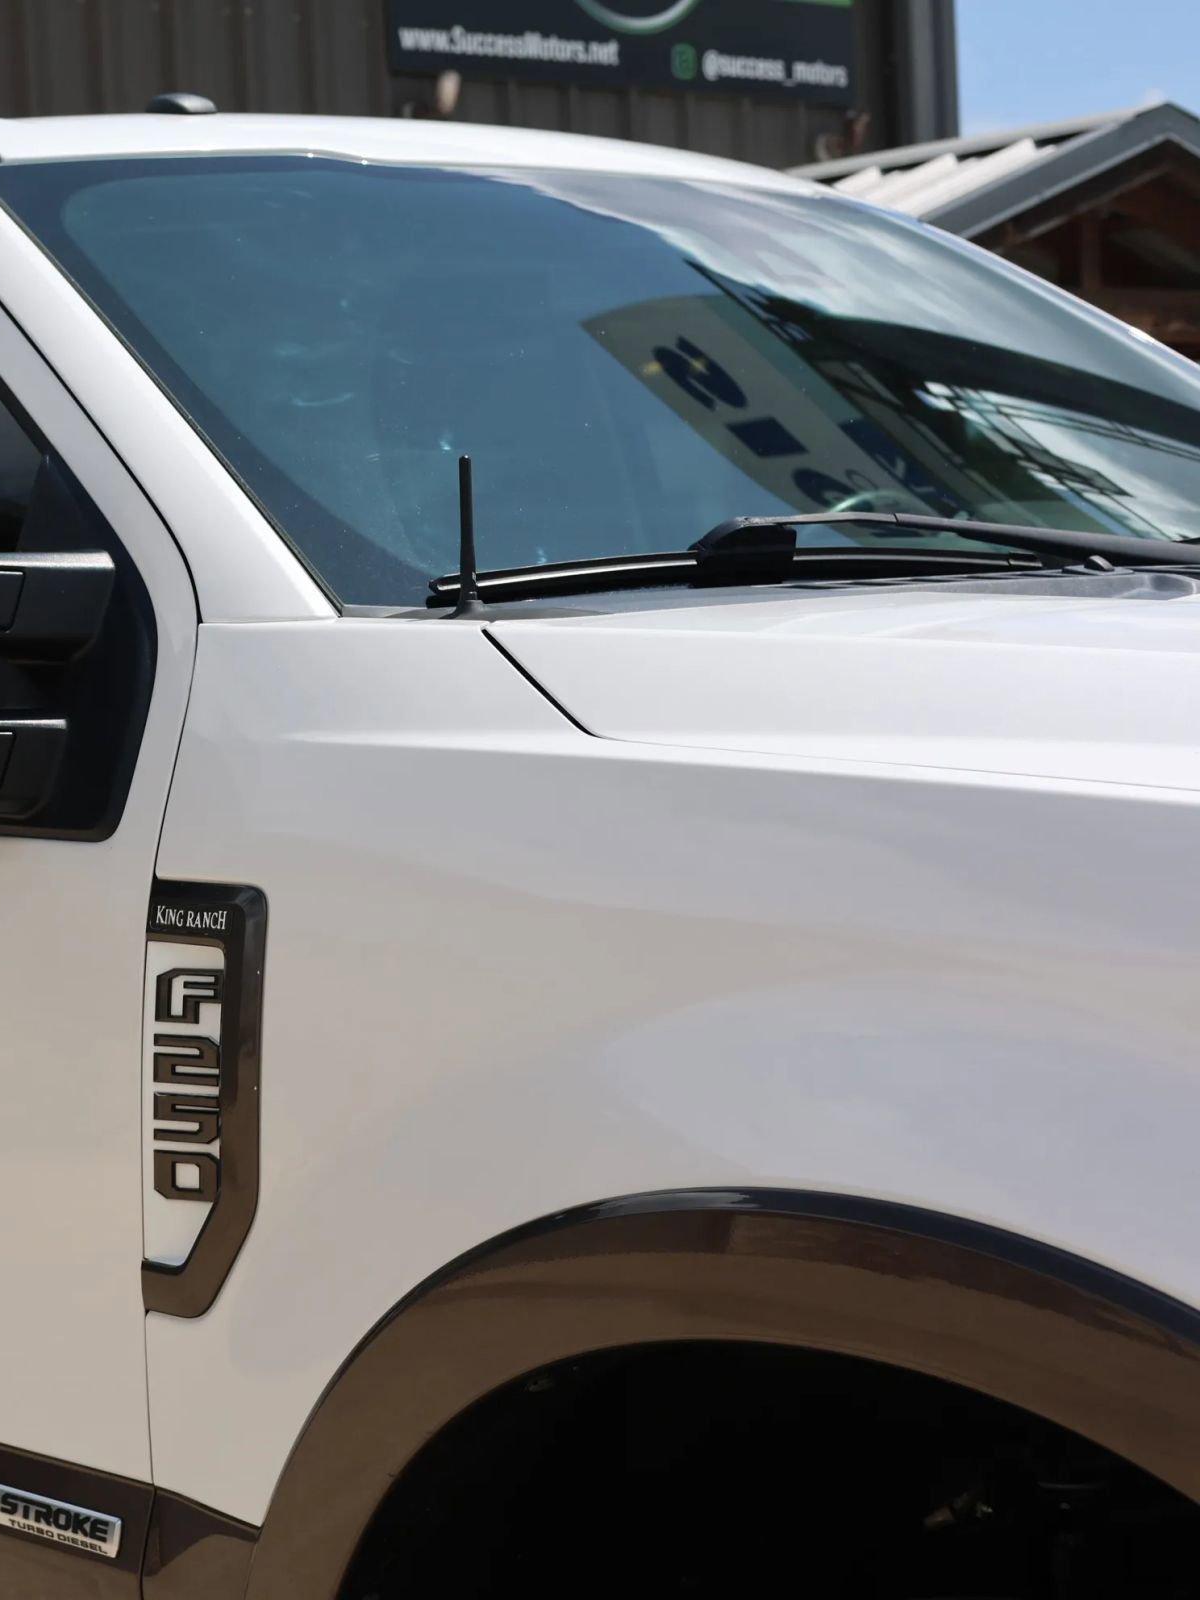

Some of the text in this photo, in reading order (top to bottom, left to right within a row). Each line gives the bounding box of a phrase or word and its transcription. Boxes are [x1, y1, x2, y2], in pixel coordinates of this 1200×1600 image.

[398, 25, 619, 66] www.SuccessMotors.net
[702, 49, 848, 88] @success_motors
[156, 905, 227, 930] KING RANCH
[154, 968, 225, 1202] F250
[0, 1493, 109, 1543] STROKE
[8, 1518, 108, 1555] TURBO DIESEL
